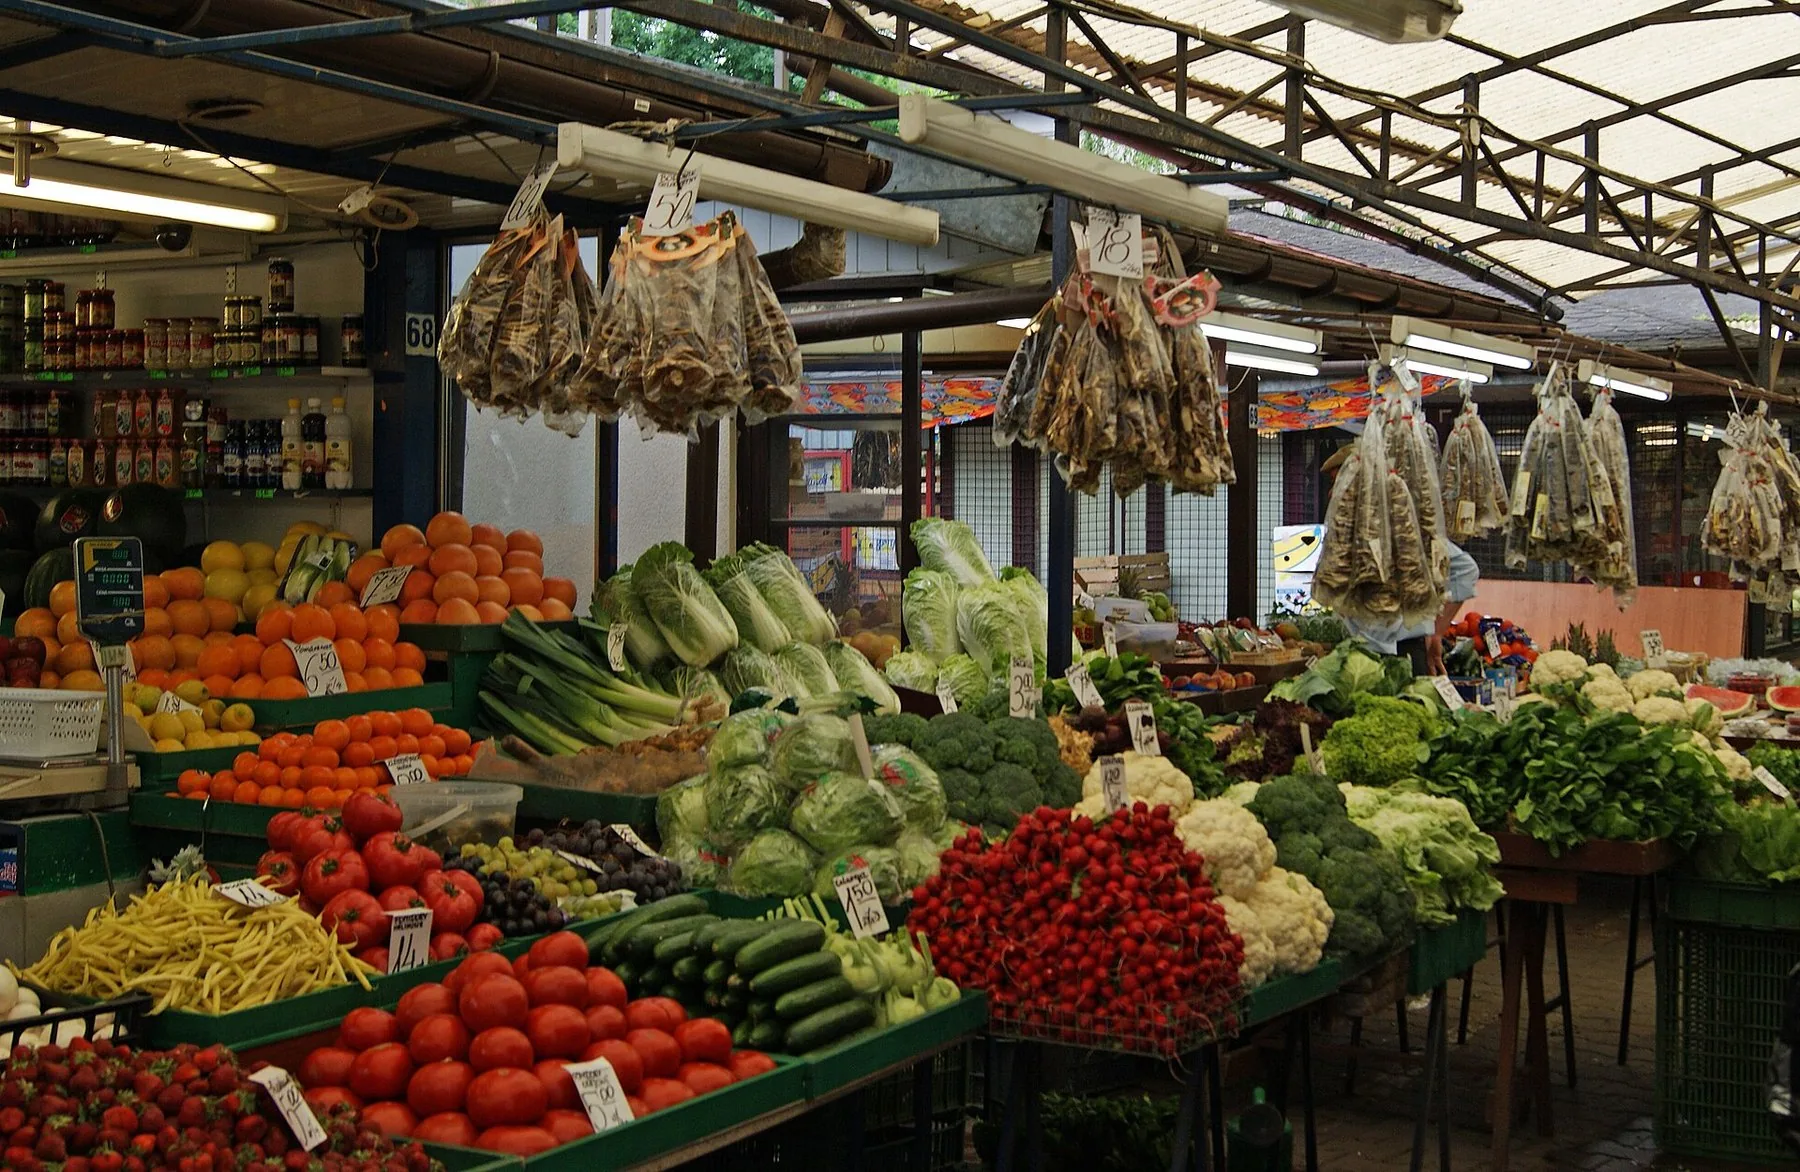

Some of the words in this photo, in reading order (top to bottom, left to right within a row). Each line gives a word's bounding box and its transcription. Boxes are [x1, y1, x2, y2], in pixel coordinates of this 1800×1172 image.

[649, 190, 692, 230] 50
[1092, 227, 1131, 264] 18
[407, 317, 434, 348] 68
